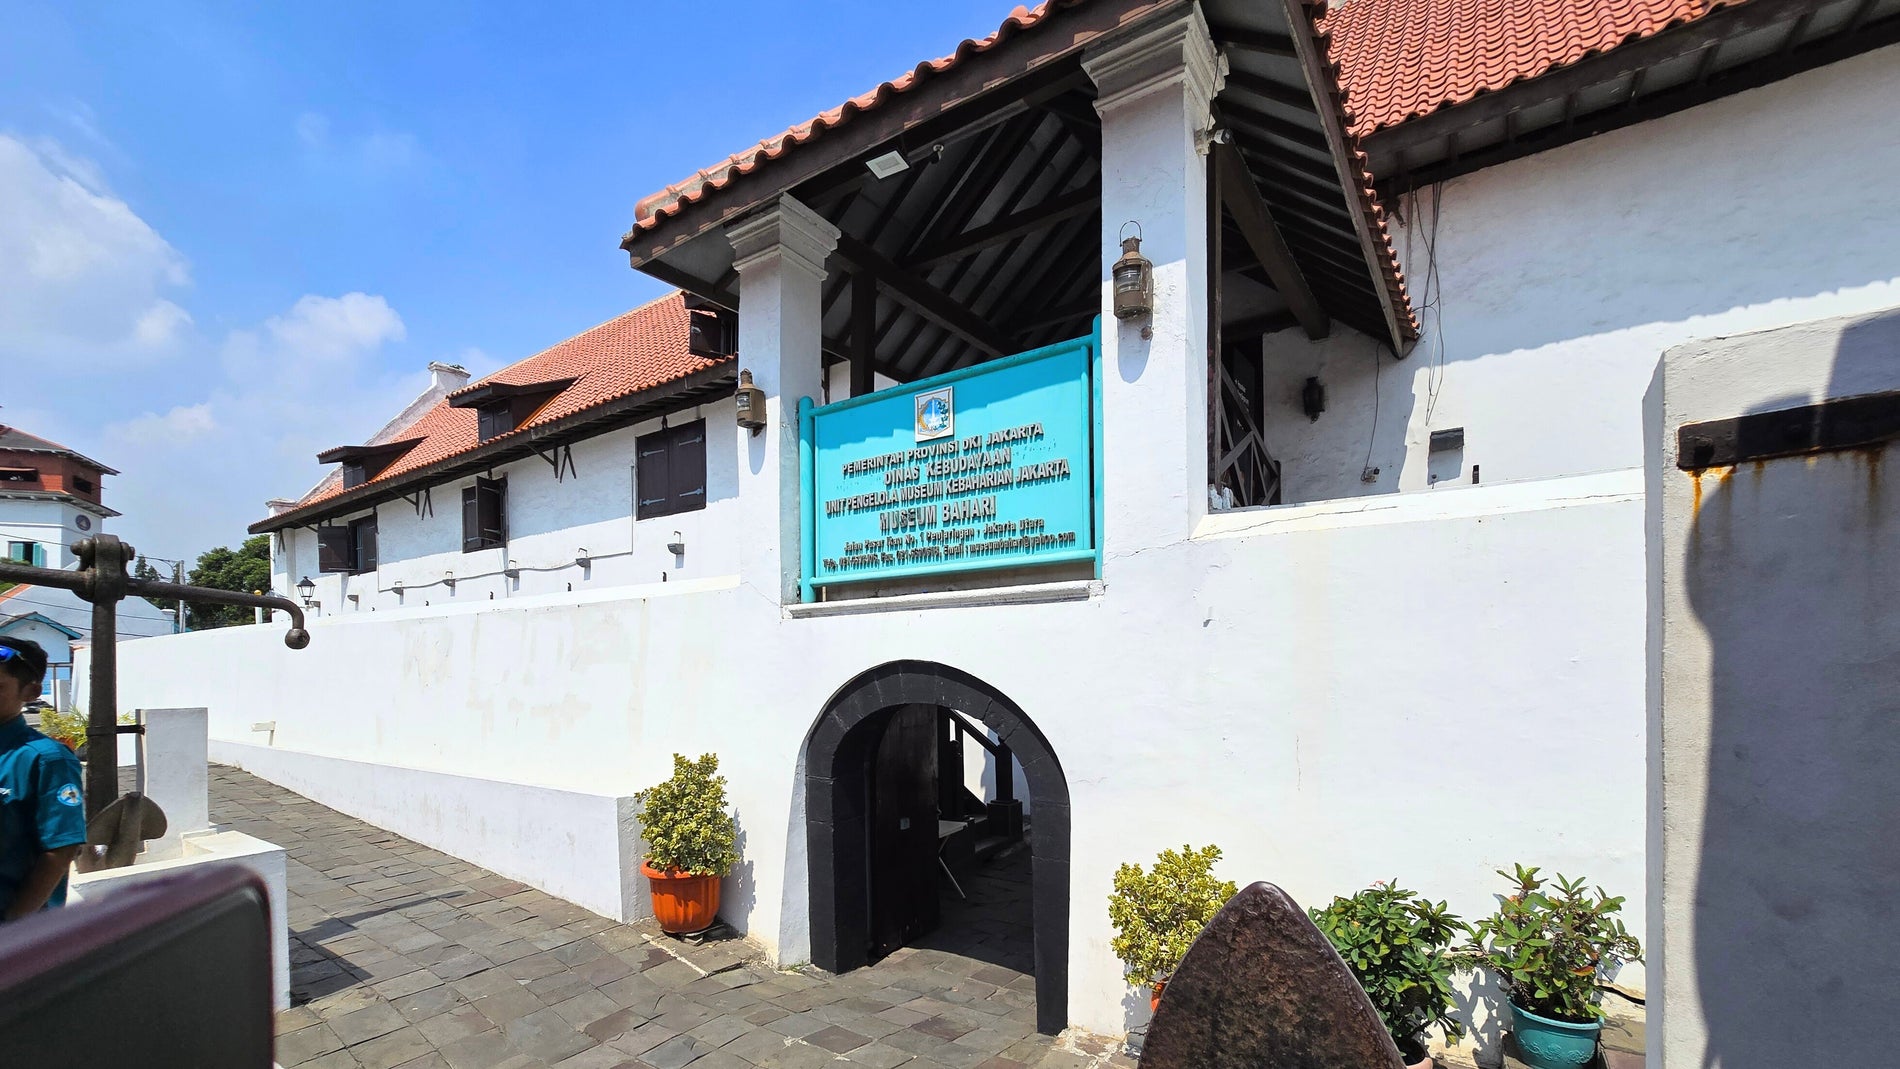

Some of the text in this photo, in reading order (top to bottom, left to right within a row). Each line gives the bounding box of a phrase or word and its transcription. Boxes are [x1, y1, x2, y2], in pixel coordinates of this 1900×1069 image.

[842, 422, 1044, 475] PEMERINTAH PROVINSI DKI JAKARTA
[884, 447, 1012, 486] DINAS KEBUDAYAAN
[825, 458, 1071, 515] UNIT PENGELOLA MUSEUM KEBAHARIAN JAKARTA
[880, 495, 997, 532] MUSEUM BAHARI
[844, 541, 864, 553] Jalan
[864, 539, 886, 551] Pasar
[886, 536, 903, 548] Ikan
[926, 527, 975, 546] Penjaringan
[984, 520, 1017, 535] Jakarta
[1019, 517, 1045, 531] Utara
[943, 542, 965, 556] Email
